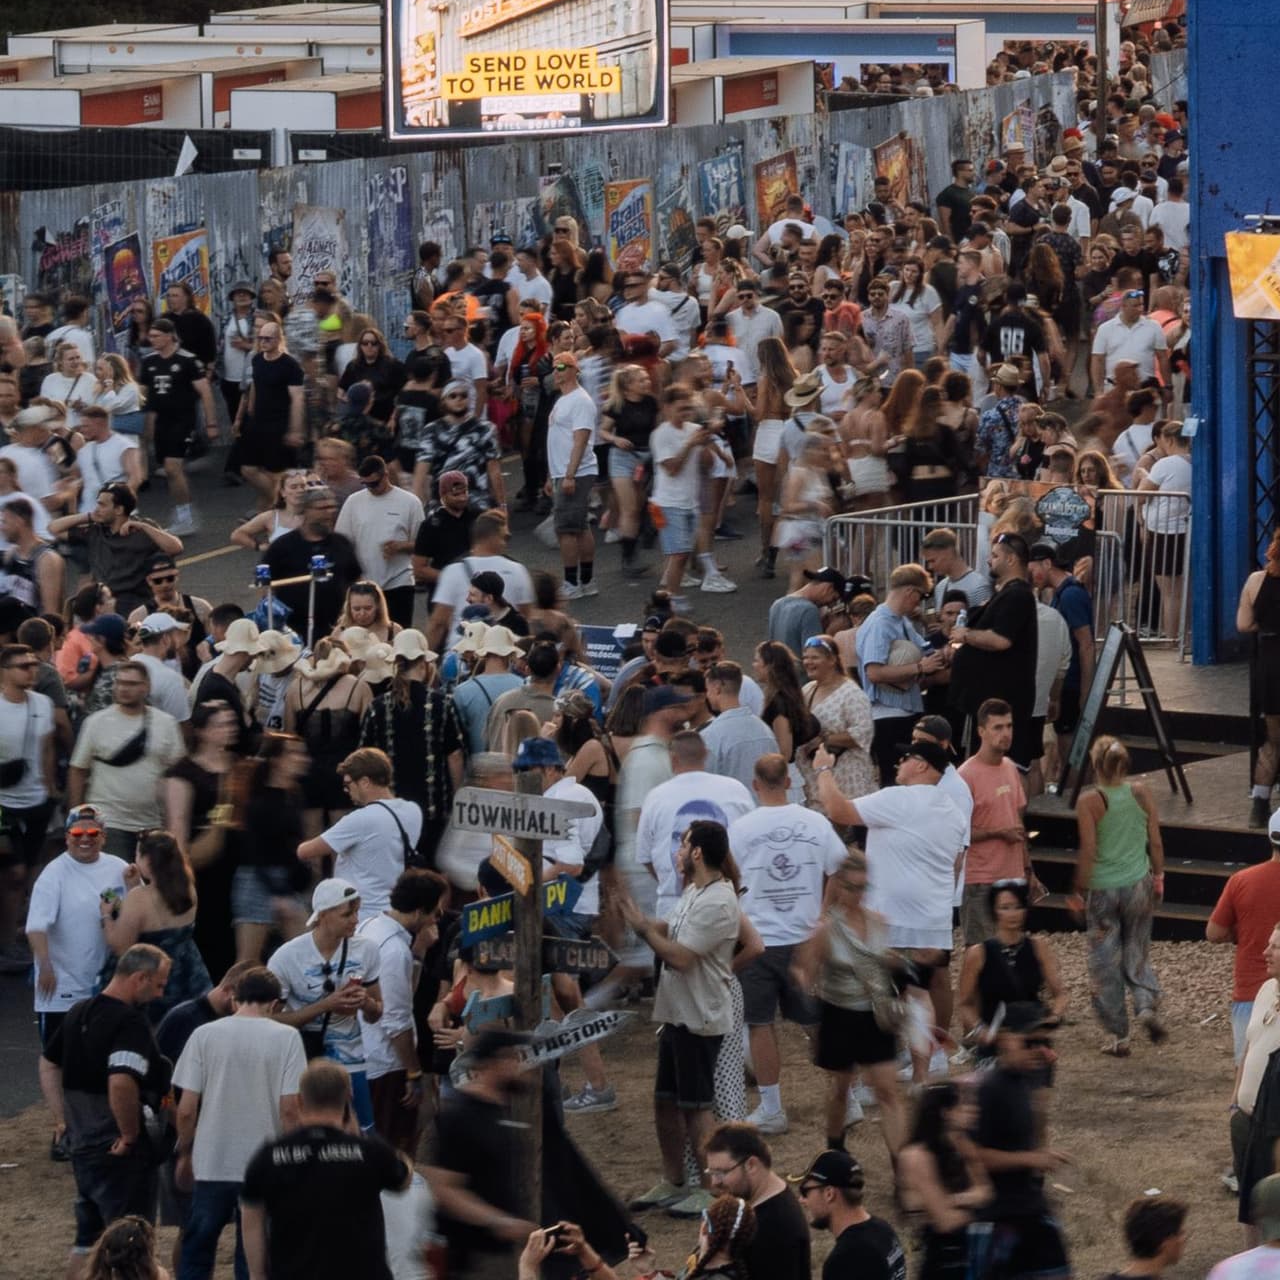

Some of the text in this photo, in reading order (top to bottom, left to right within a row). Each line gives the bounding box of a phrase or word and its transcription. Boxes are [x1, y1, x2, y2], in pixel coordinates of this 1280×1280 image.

[469, 53, 590, 73] SEND LOVE
[446, 71, 613, 94] TO THE WORLD
[609, 194, 645, 232] Brain
[615, 221, 649, 249] Wash
[456, 802, 560, 836] TOWNHALL
[546, 881, 568, 908] PV
[468, 899, 512, 933] BANK
[566, 946, 609, 969] CLUB
[533, 1013, 619, 1057] FACTORY
